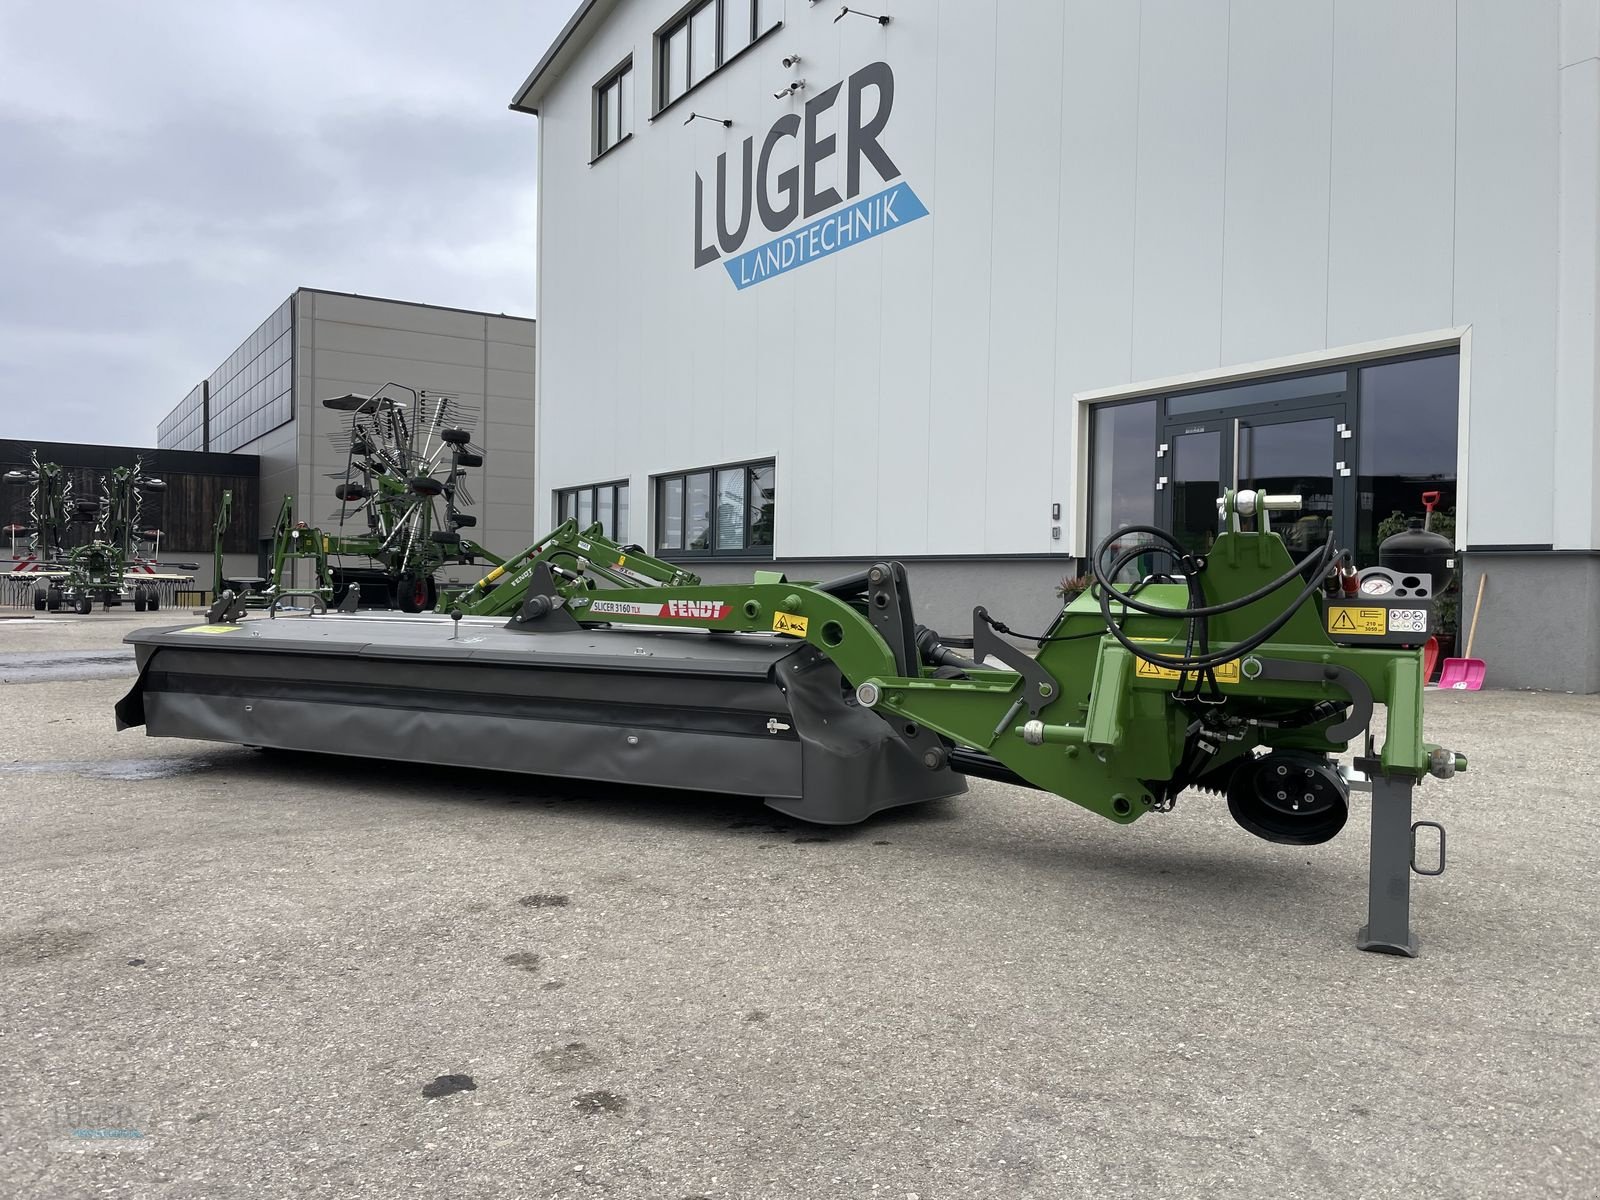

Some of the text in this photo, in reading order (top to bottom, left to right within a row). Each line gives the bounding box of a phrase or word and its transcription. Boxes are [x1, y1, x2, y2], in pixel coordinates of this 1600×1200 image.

[694, 61, 902, 270] LUGER
[741, 190, 899, 285] LANDTECHNIK
[510, 567, 534, 587] FENDT
[594, 602, 641, 614] SLICER 3160 TLX
[668, 599, 724, 618] FENDT
